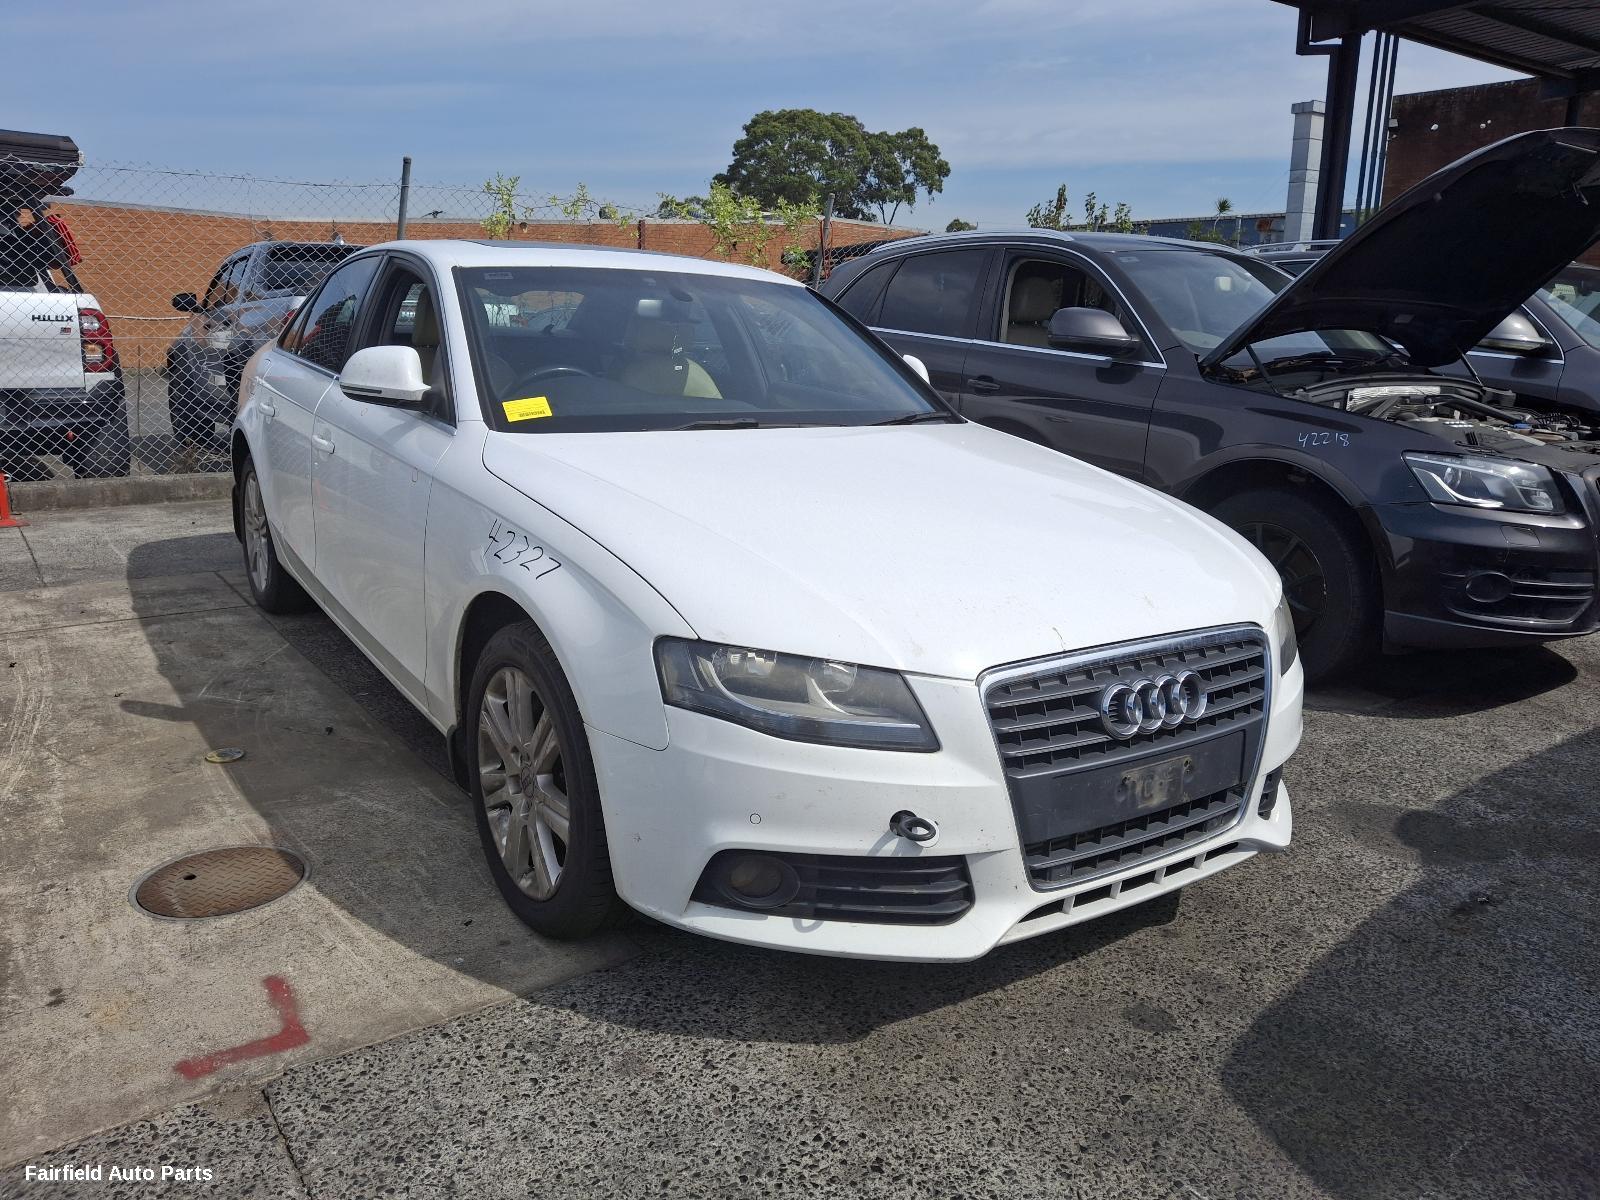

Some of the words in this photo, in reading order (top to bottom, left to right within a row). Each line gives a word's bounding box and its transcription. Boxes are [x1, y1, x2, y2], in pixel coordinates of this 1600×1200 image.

[31, 314, 74, 322] HILUX
[1298, 432, 1351, 448] 42218
[484, 518, 561, 579] 42327
